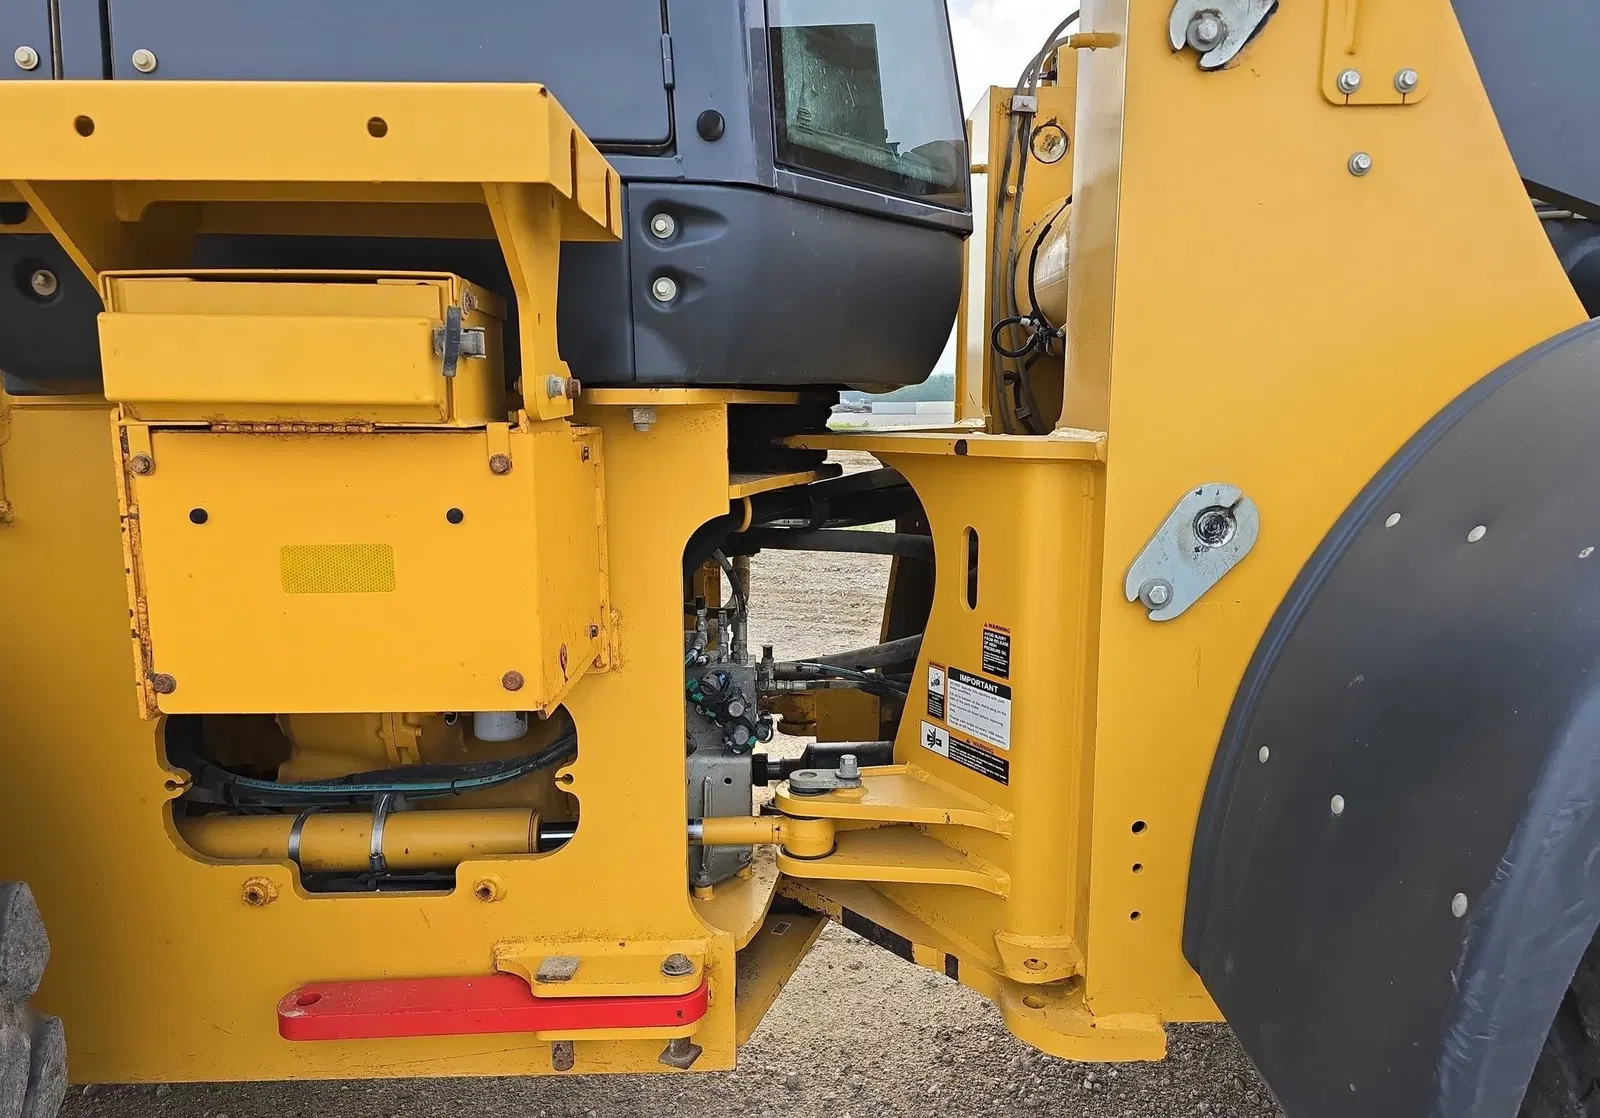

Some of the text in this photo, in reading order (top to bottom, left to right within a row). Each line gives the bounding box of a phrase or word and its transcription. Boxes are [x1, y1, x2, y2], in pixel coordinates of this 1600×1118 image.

[988, 623, 1010, 633] WARNING
[994, 639, 1009, 647] RELEASE
[960, 674, 998, 693] IMPORTANT
[973, 742, 994, 753] WARNING
